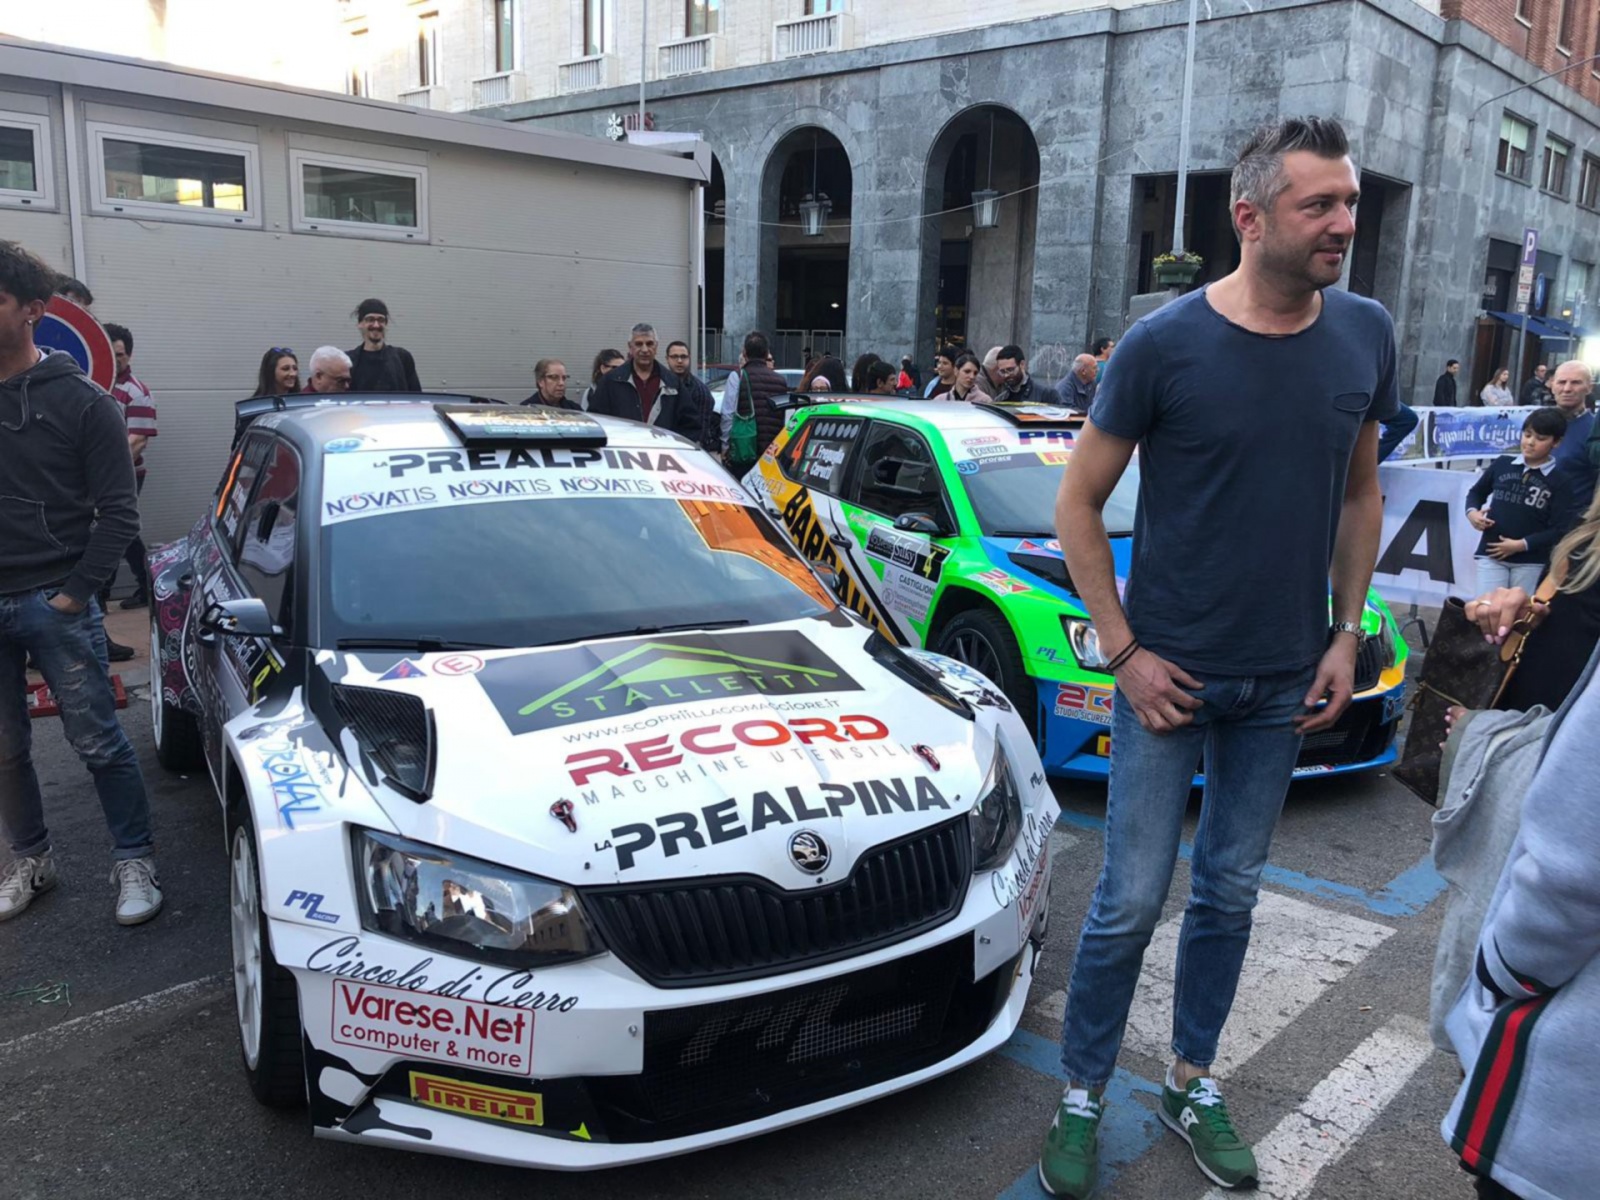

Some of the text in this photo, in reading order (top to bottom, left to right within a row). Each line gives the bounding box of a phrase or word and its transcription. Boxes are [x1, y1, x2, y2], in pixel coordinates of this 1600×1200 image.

[1524, 231, 1535, 261] P
[389, 449, 687, 477] PREALPINA
[791, 424, 811, 466] 4
[957, 463, 978, 473] SD
[326, 487, 436, 516] NOVATIS
[448, 478, 551, 498] NOVATIS
[560, 477, 654, 493] NOVATIS
[661, 479, 744, 501] NOVATIS
[1525, 486, 1552, 509] 36
[923, 551, 938, 578] 4
[551, 673, 818, 717] STALLETTI
[1055, 706, 1079, 718] STUDIO
[565, 715, 889, 786] RECORD
[581, 743, 910, 805] MACCHINE UTENSILI
[594, 776, 951, 871] LA PREALPINA
[307, 936, 578, 1013] Circolo di Cerro
[341, 985, 525, 1044] Varese.Net
[341, 1024, 521, 1068] computer & more
[415, 1077, 537, 1121] PIRELLI
